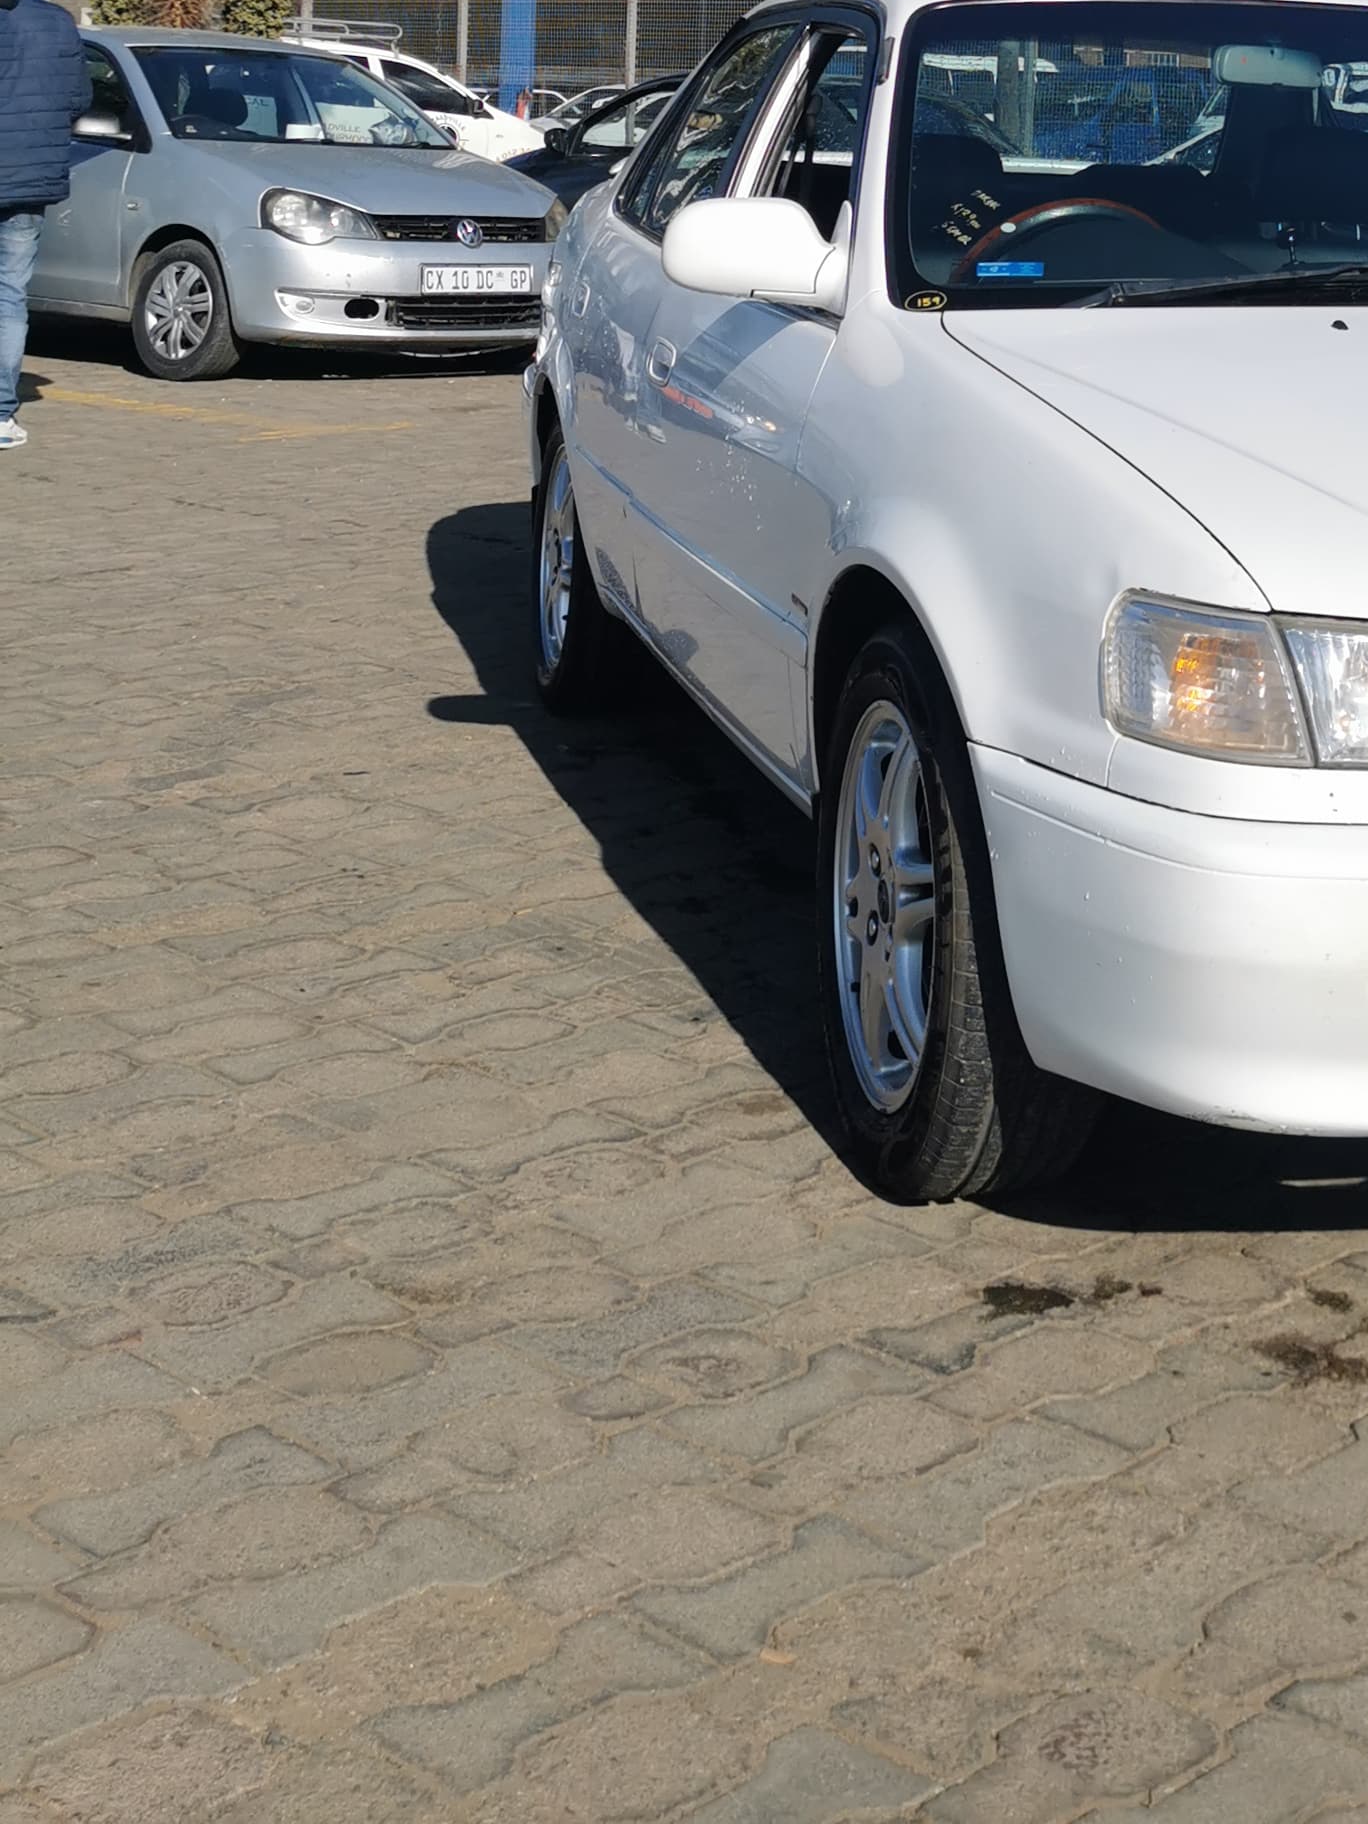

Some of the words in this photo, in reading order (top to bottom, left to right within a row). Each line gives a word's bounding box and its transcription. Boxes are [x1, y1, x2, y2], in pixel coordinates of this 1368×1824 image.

[426, 270, 444, 290] CX
[451, 270, 470, 290] 10
[476, 270, 494, 290] DC
[510, 270, 527, 290] GP
[916, 295, 941, 308] 159
